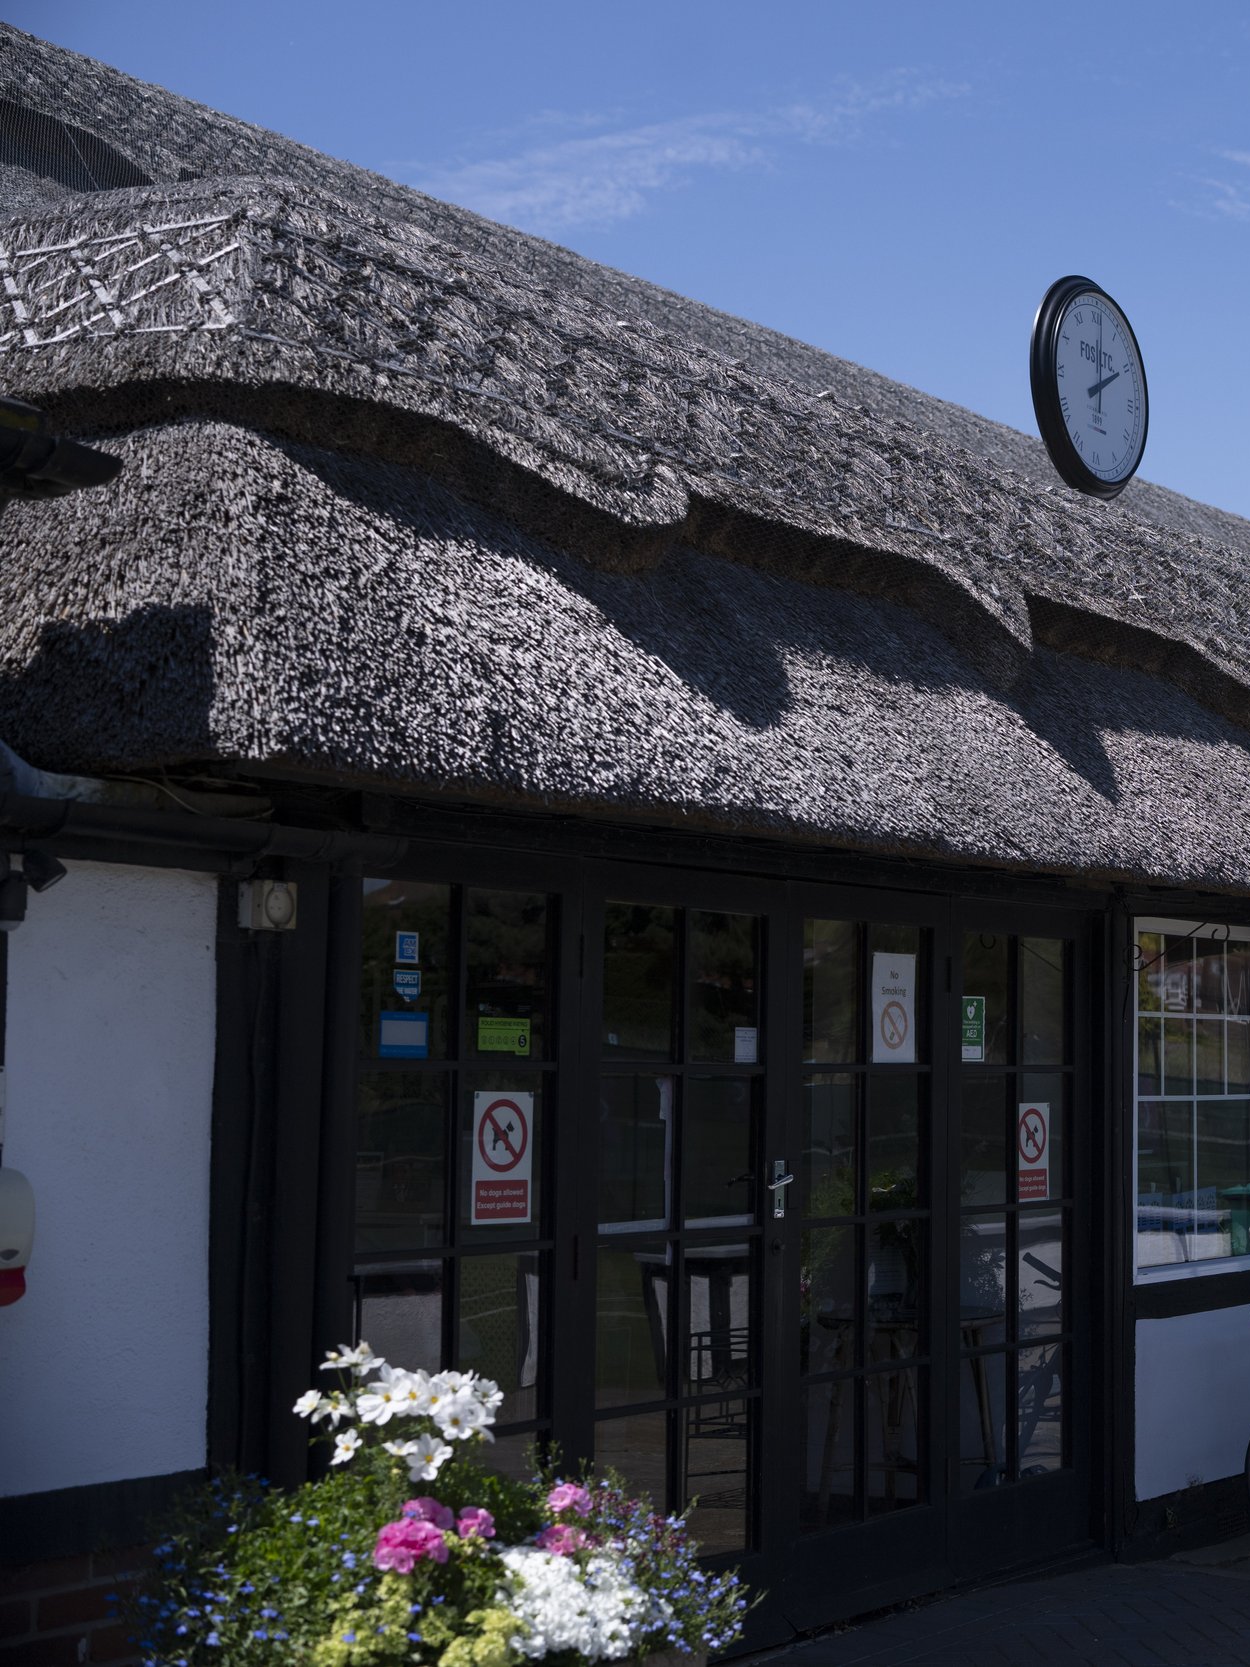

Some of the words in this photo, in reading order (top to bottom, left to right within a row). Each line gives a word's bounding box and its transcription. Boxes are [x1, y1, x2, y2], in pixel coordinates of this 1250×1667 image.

[1080, 340, 1096, 364] FOS
[396, 974, 418, 984] RESPECT
[890, 970, 899, 980] No
[881, 987, 906, 997] Smoking
[520, 1036, 526, 1046] 5
[480, 1189, 488, 1197] No
[488, 1189, 502, 1198] dogs
[503, 1188, 524, 1196] allowed
[477, 1201, 496, 1210] Except
[496, 1201, 511, 1210] guide
[512, 1200, 526, 1209] dogs
